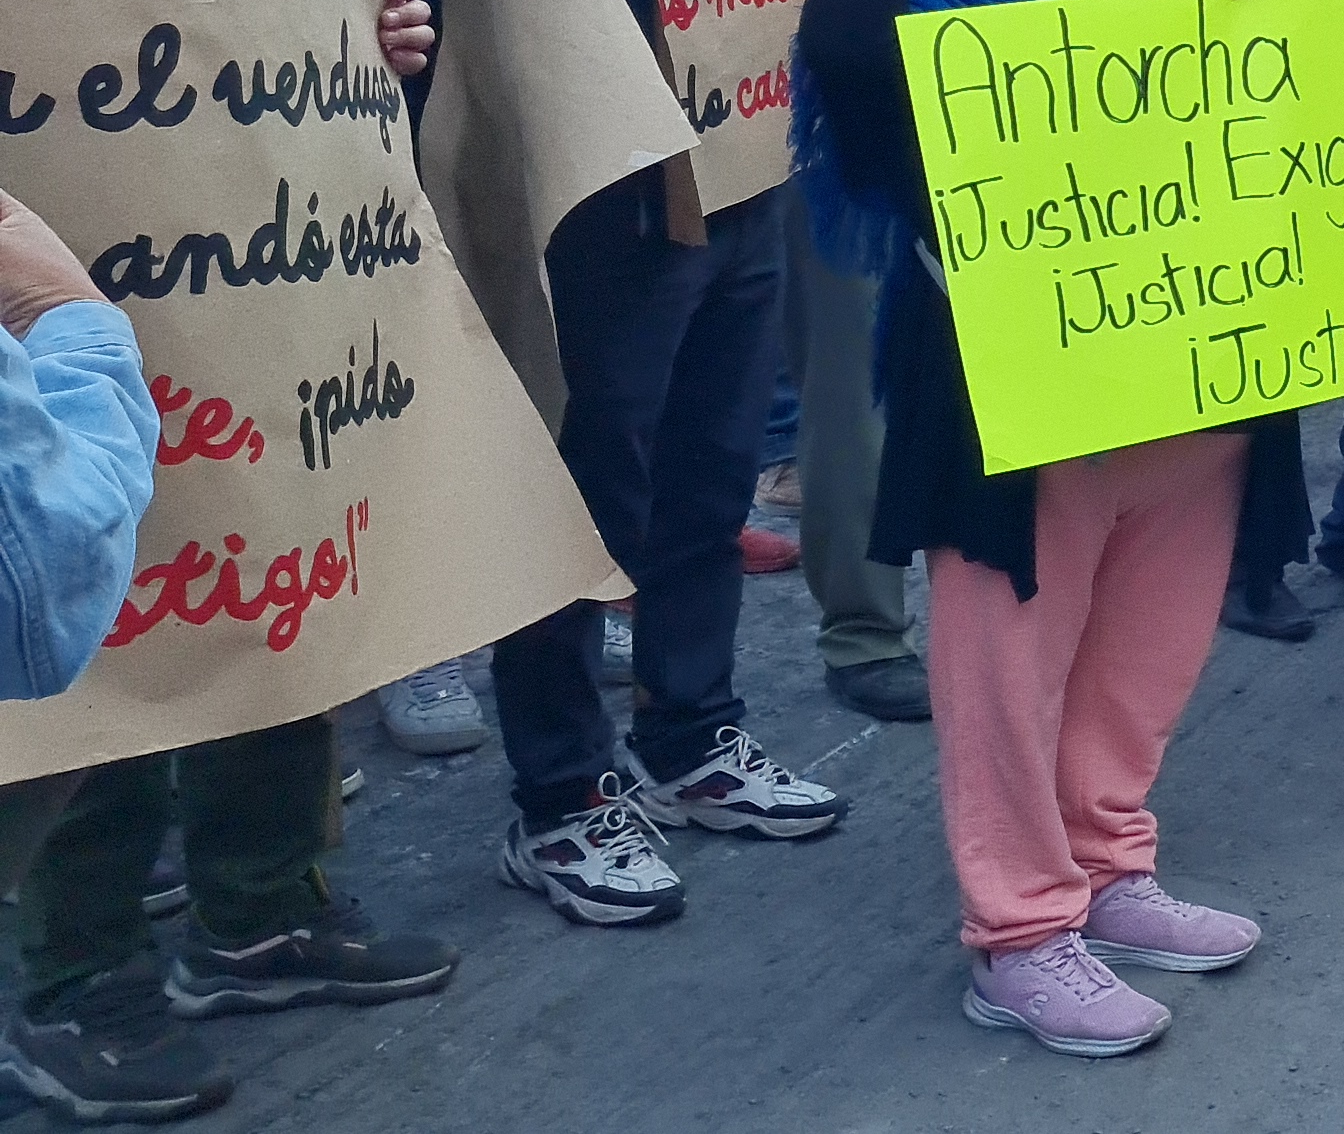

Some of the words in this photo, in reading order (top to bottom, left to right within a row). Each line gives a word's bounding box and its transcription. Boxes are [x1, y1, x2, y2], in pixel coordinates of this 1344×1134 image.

[77, 23, 197, 132] el
[212, 18, 401, 154] verdugo
[339, 186, 421, 278] esta
[935, 140, 1201, 272] ¡Justicia!
[1053, 211, 1305, 348] ¡Justicia!
